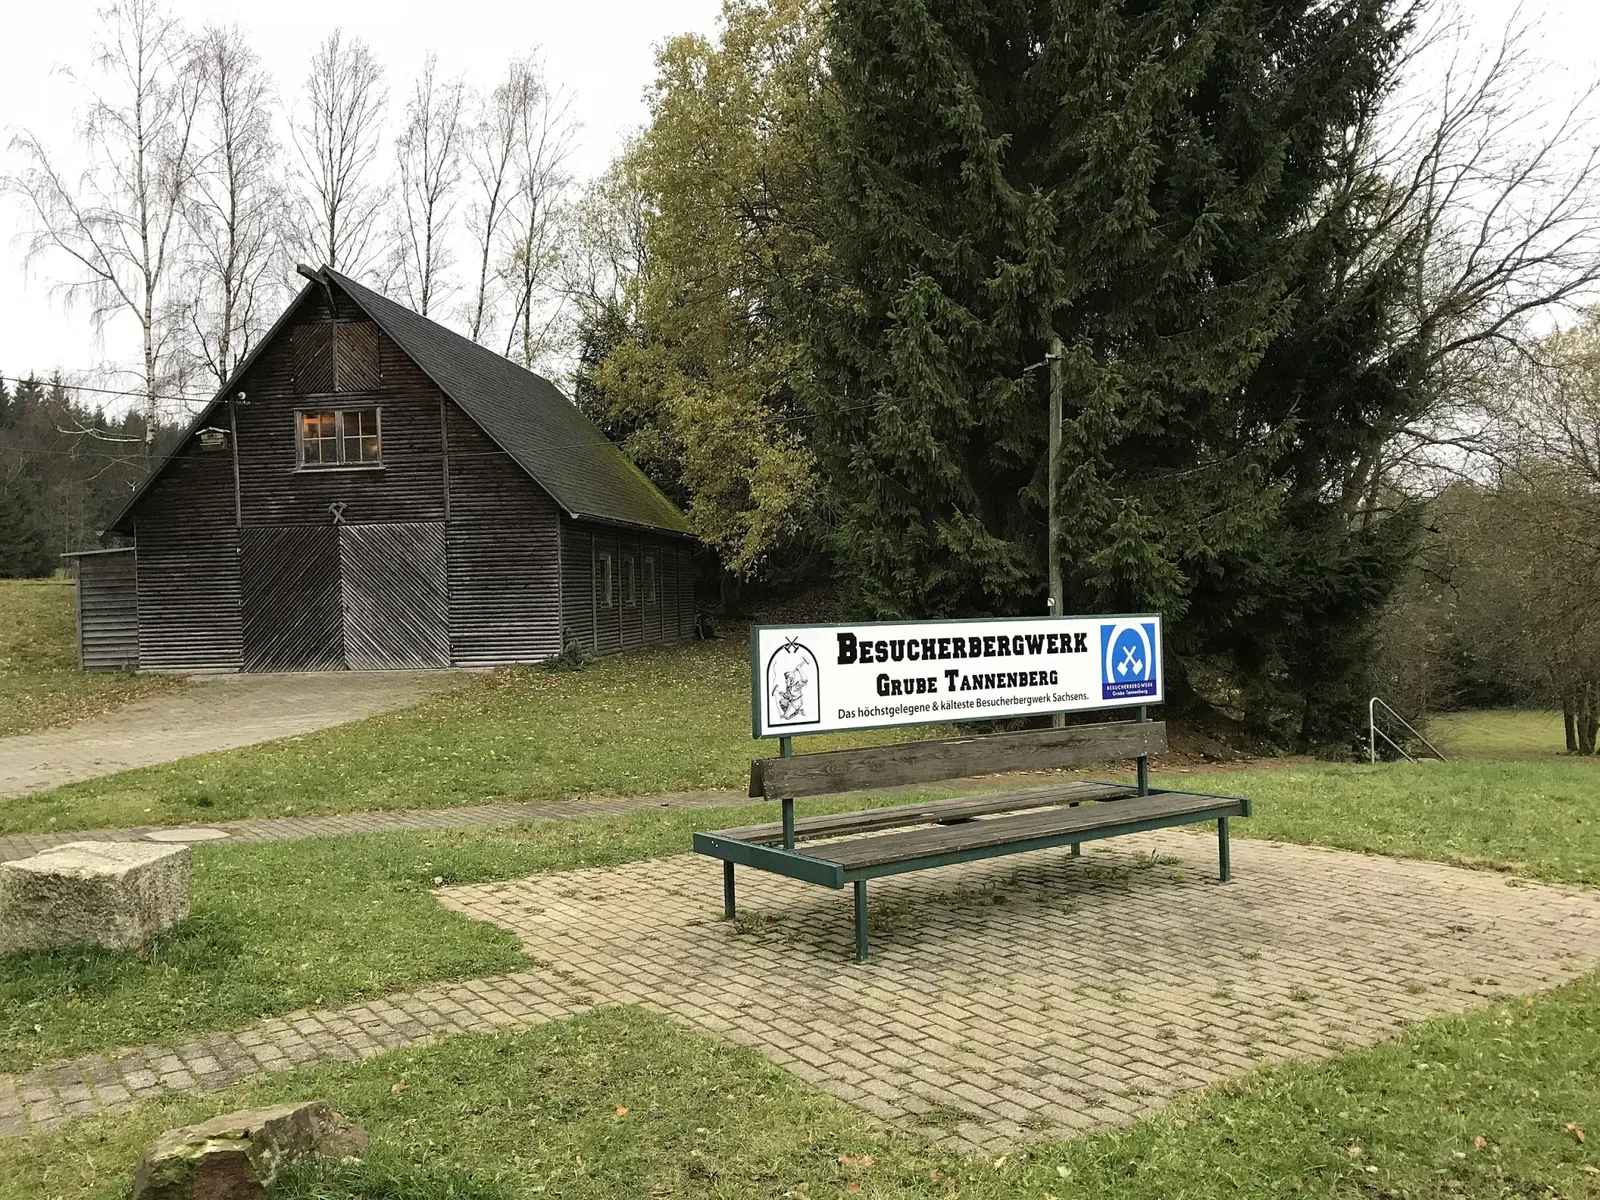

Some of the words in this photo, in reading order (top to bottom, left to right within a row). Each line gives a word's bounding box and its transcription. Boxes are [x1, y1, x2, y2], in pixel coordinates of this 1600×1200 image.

[837, 632, 1088, 665] BESUCHERBERGWERK
[876, 673, 938, 697] GRUBE
[944, 669, 1059, 692] TANNENBERG
[838, 709, 856, 719] Das
[857, 703, 931, 718] höchstgelegene
[932, 701, 939, 711] &
[940, 699, 975, 711] kälteste
[976, 693, 1051, 707] Besucherbergwerk
[1052, 692, 1090, 703] Sachsens.
